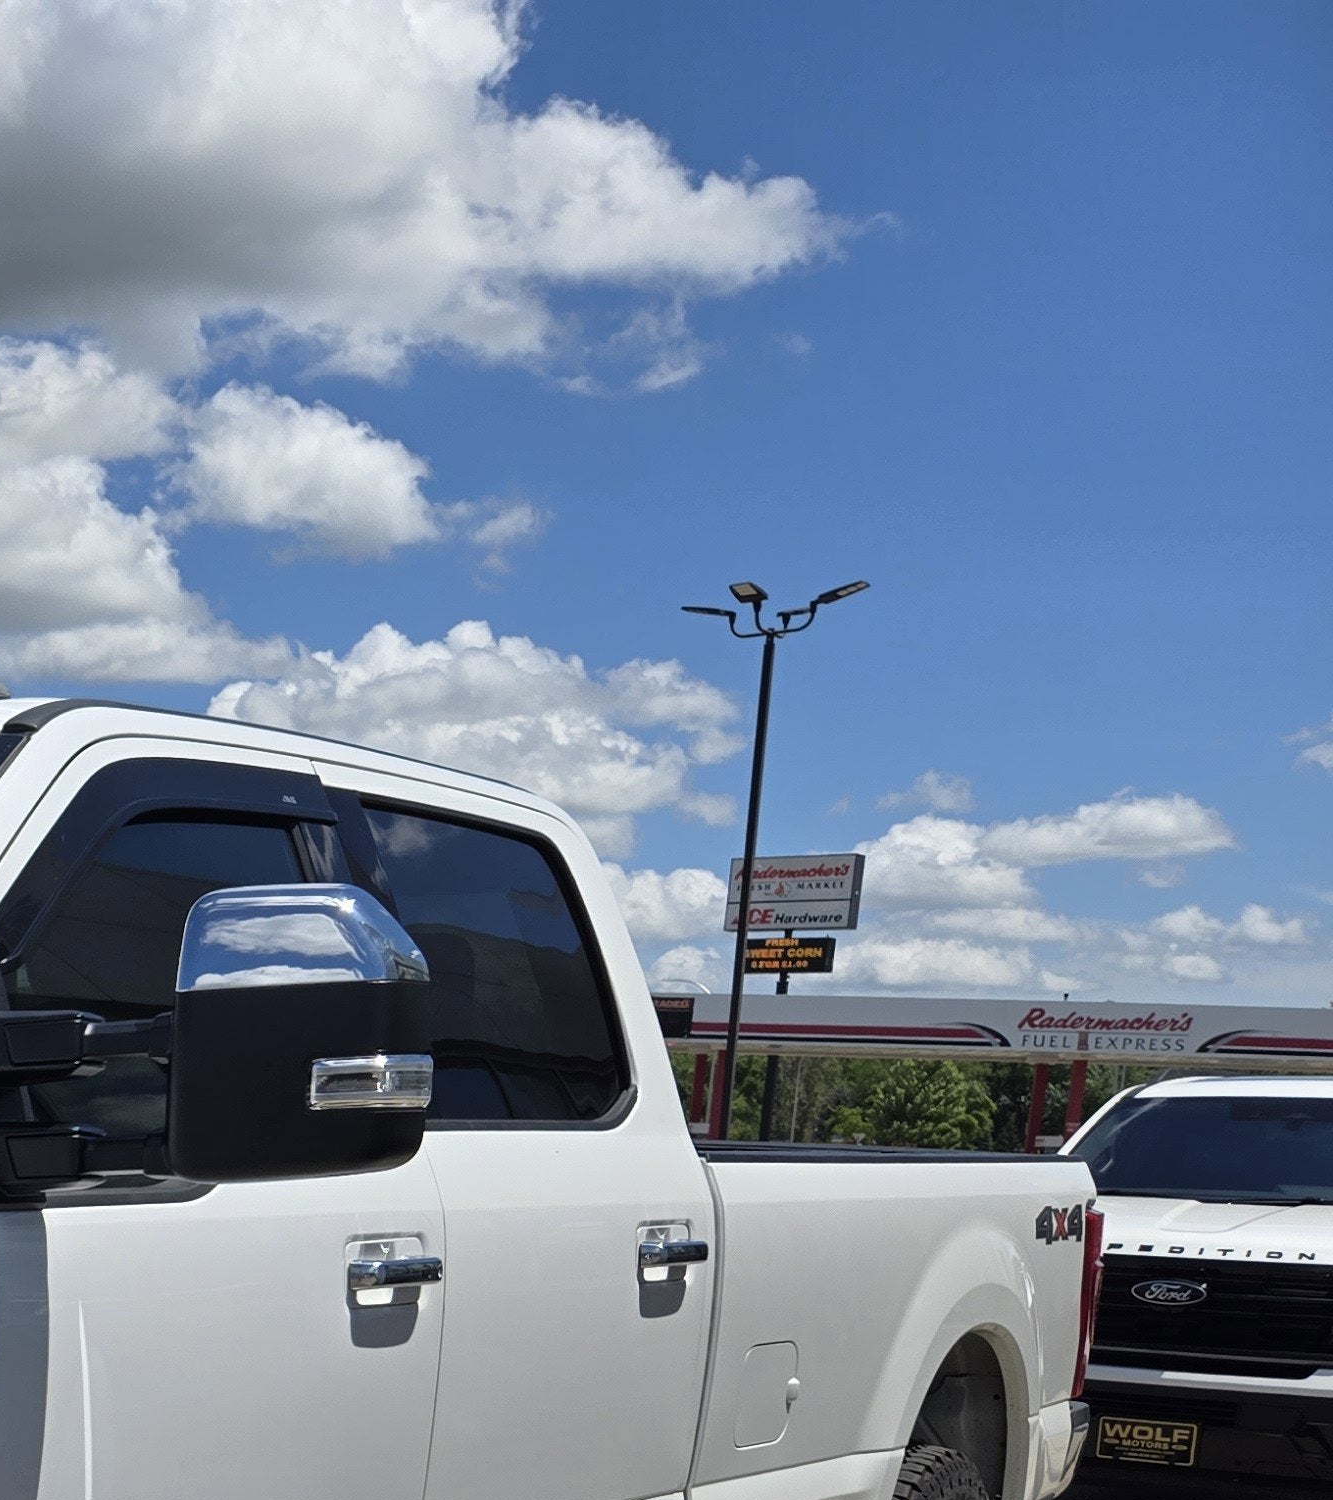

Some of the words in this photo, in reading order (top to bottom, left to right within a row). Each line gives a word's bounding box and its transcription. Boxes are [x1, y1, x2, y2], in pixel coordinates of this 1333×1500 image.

[735, 863, 850, 880] adermacher's
[796, 881, 844, 890] MARKET
[774, 912, 843, 925] Hardware
[787, 947, 823, 958] CORN
[1018, 1008, 1194, 1032] Radermacher's
[1022, 1034, 1071, 1048] FUEL
[1094, 1036, 1185, 1051] EXPRESS
[1106, 1243, 1316, 1260] PEDITION
[1144, 1282, 1192, 1302] Ford
[1104, 1422, 1190, 1443] WOLF
[1122, 1439, 1169, 1450] MOTORS
